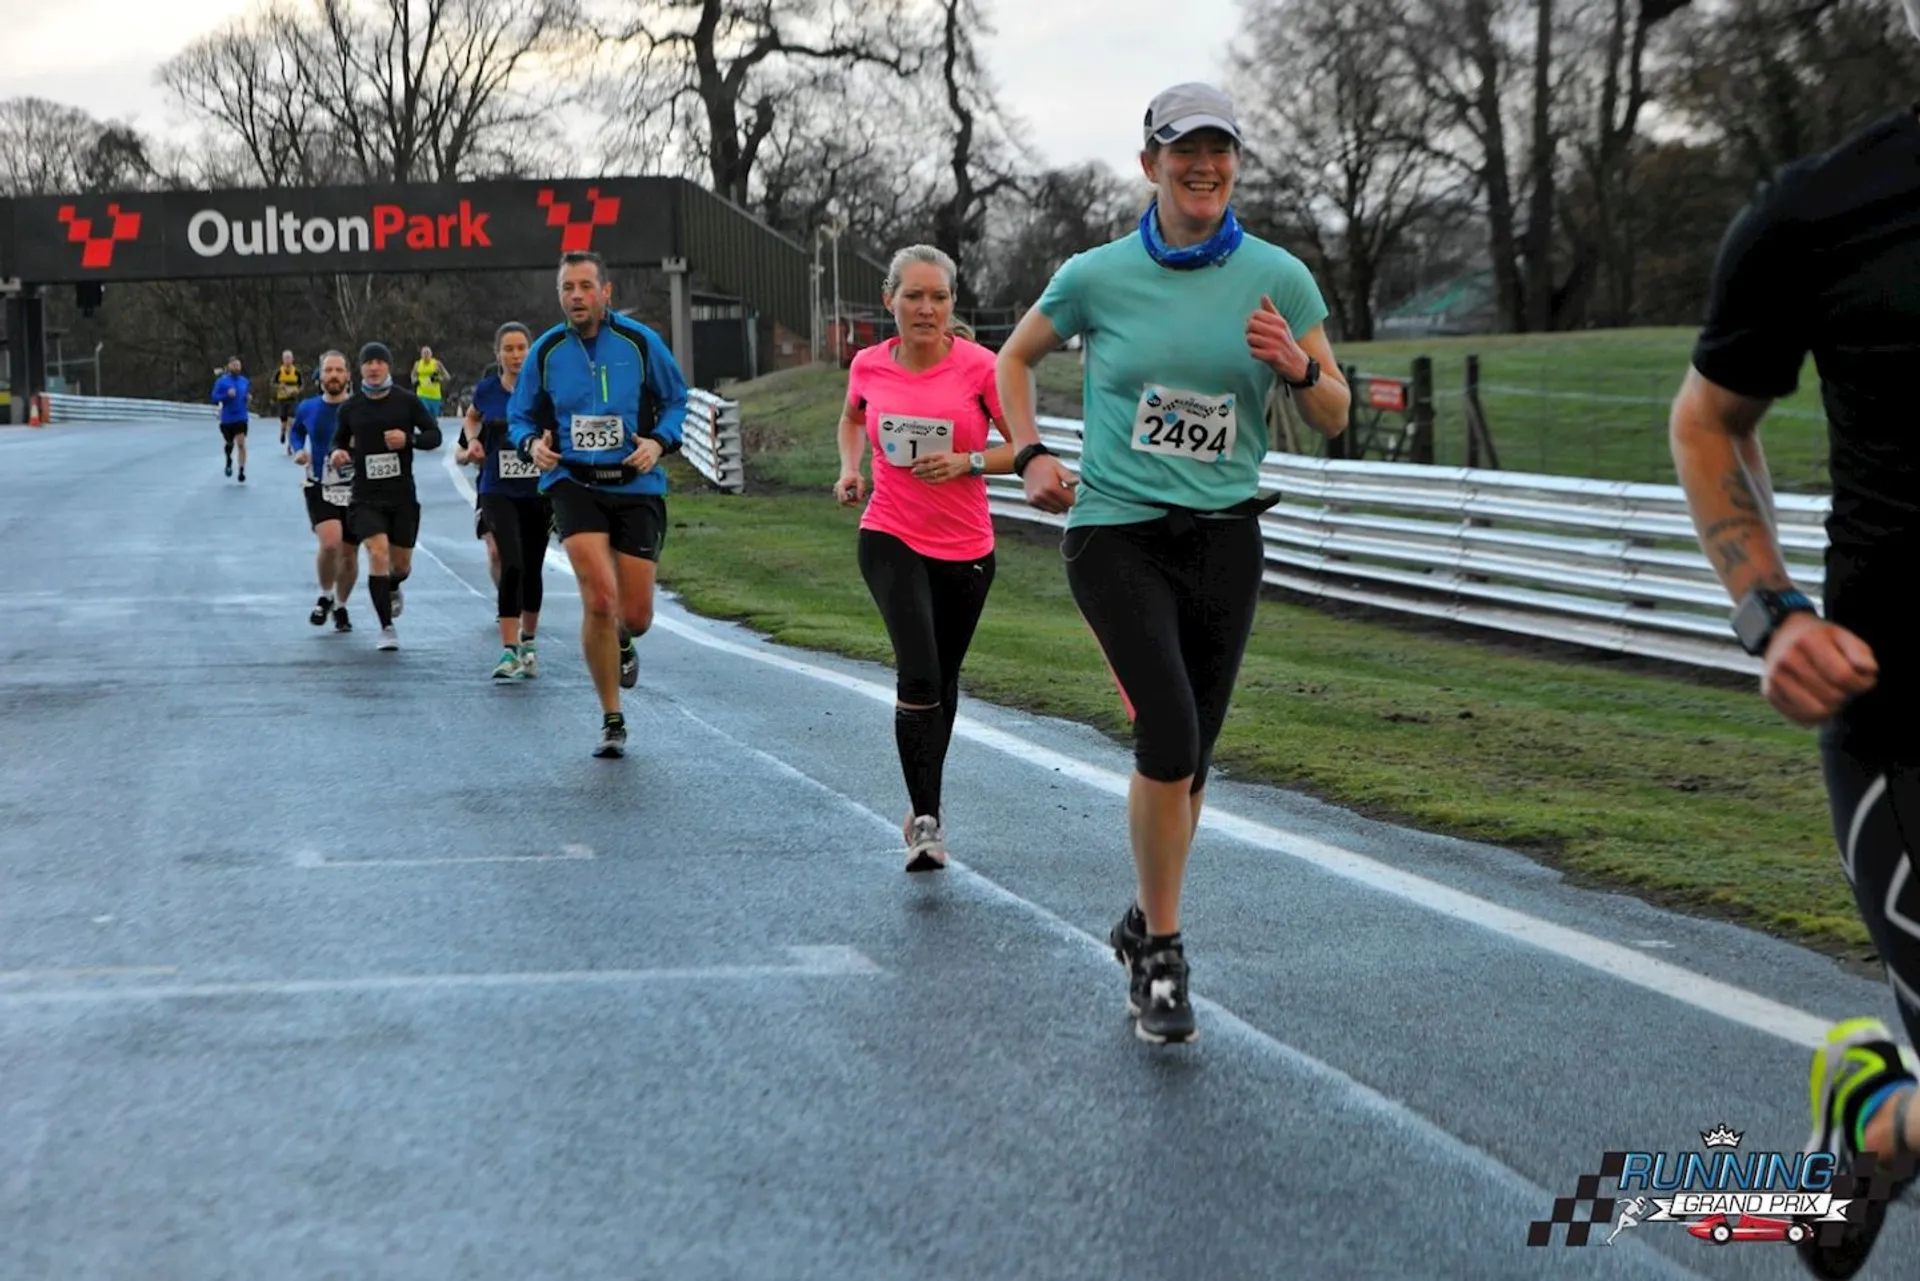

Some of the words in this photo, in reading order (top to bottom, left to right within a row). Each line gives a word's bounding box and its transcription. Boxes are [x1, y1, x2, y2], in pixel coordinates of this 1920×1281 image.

[575, 430, 619, 448] 2355
[1144, 415, 1227, 455] 2494
[370, 464, 398, 476] 2824
